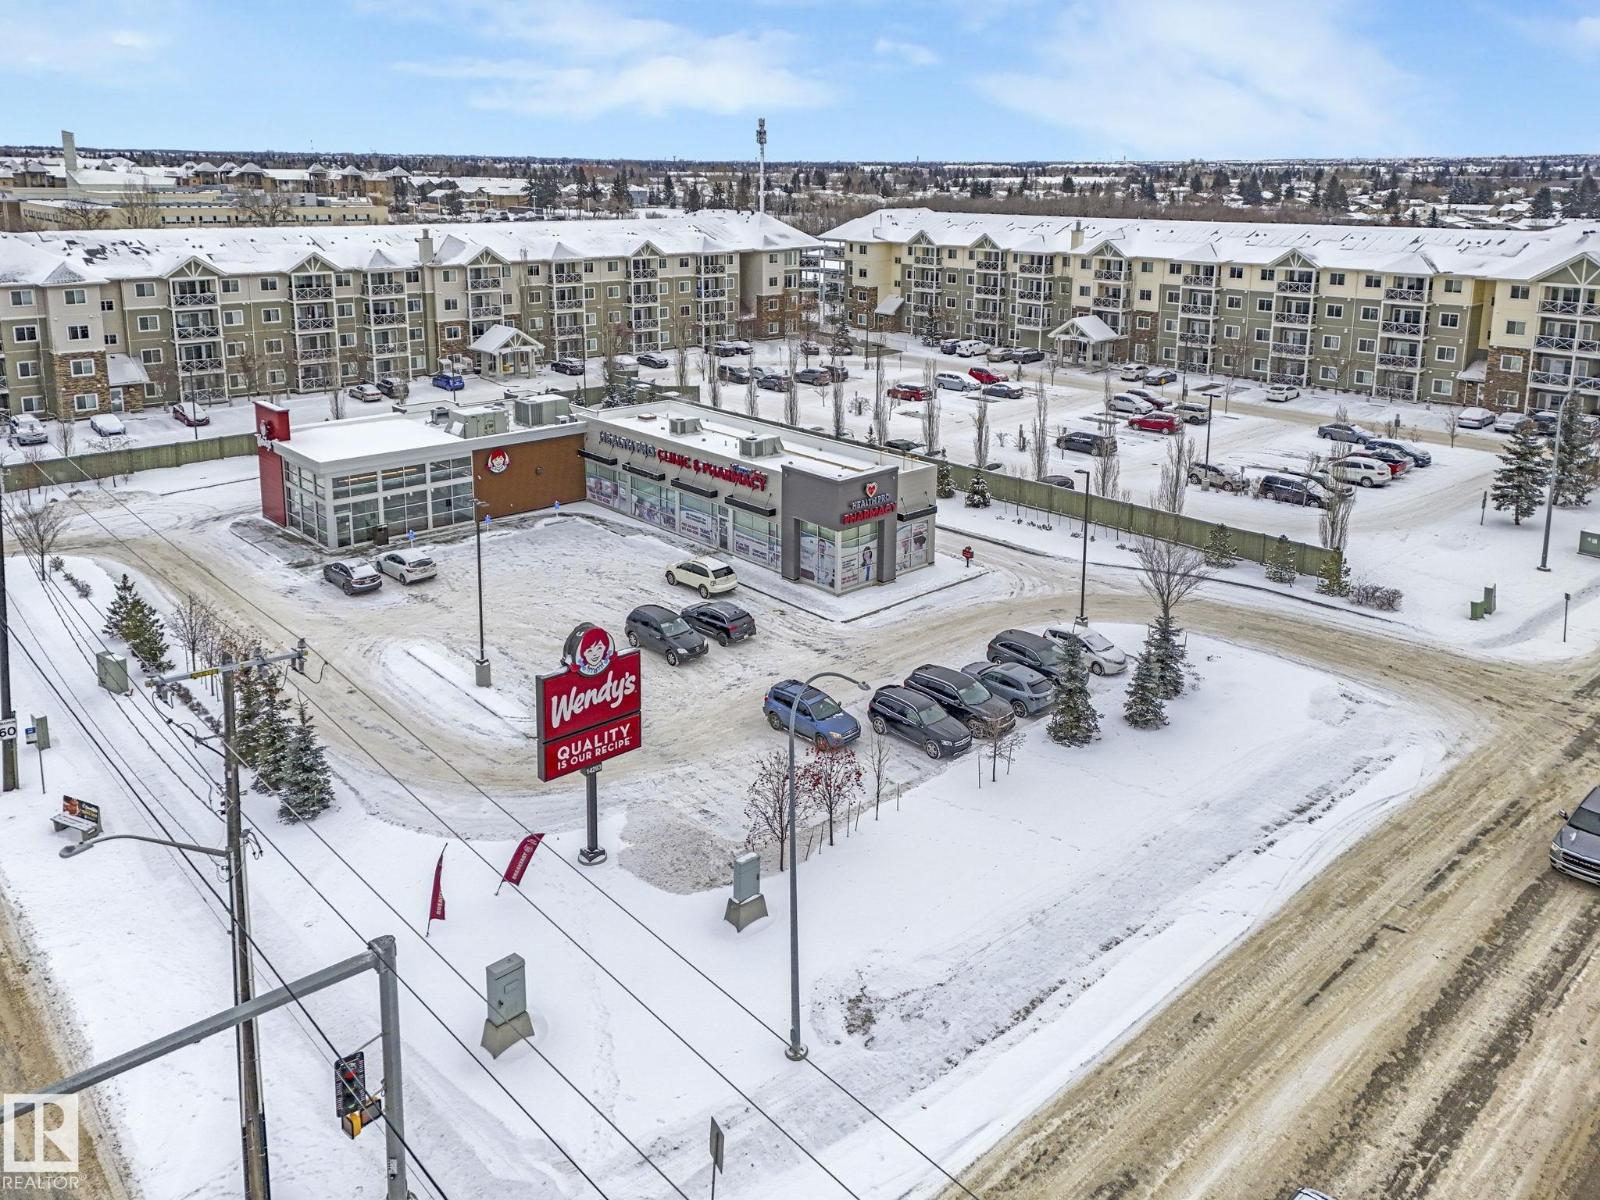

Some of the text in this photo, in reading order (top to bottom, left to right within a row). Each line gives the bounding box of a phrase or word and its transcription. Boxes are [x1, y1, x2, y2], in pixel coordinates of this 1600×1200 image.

[841, 503, 897, 525] PHARMACY
[551, 670, 636, 728] Wendy's
[557, 723, 631, 760] QUALITY
[557, 737, 631, 771] IS OUR RECIPE
